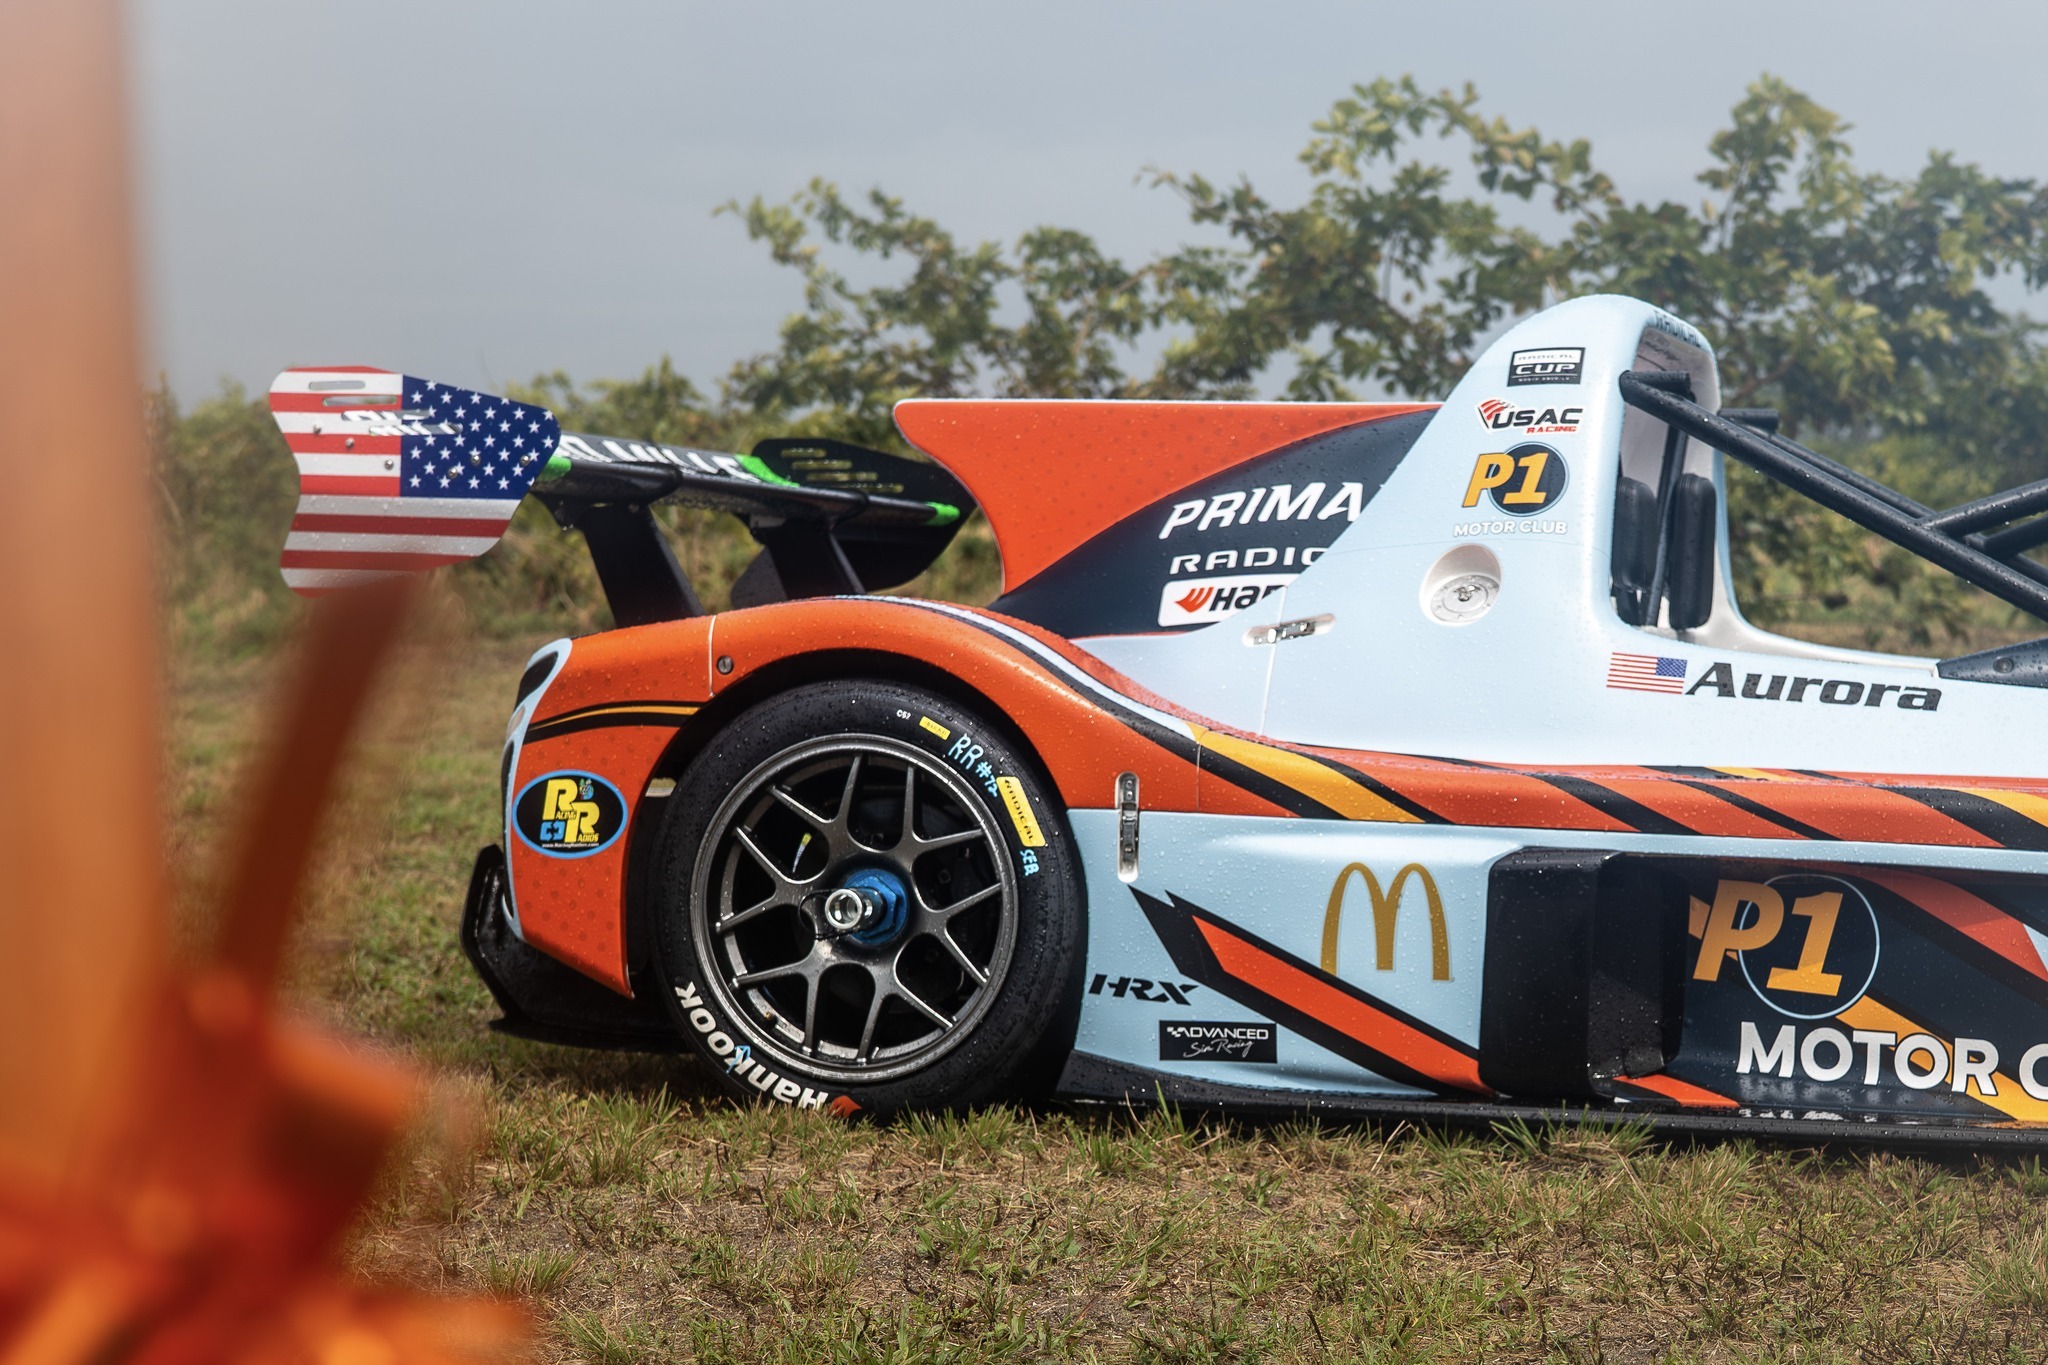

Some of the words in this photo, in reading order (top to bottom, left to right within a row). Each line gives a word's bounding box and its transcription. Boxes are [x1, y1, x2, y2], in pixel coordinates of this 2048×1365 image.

[1516, 363, 1575, 374] CUP
[1492, 408, 1583, 429] USAC
[1526, 426, 1577, 434] RACING
[1462, 452, 1548, 508] P1
[1453, 520, 1516, 537] MOTOR
[1519, 520, 1567, 535] CLUB
[1685, 662, 1942, 712] Aurora
[948, 733, 984, 770] RR
[1692, 879, 1844, 997] P1
[1088, 973, 1199, 1006] HRX
[675, 981, 829, 1110] Hankook
[1177, 1026, 1269, 1040] ADVANCED
[1736, 1021, 1999, 1096] MOTOR
